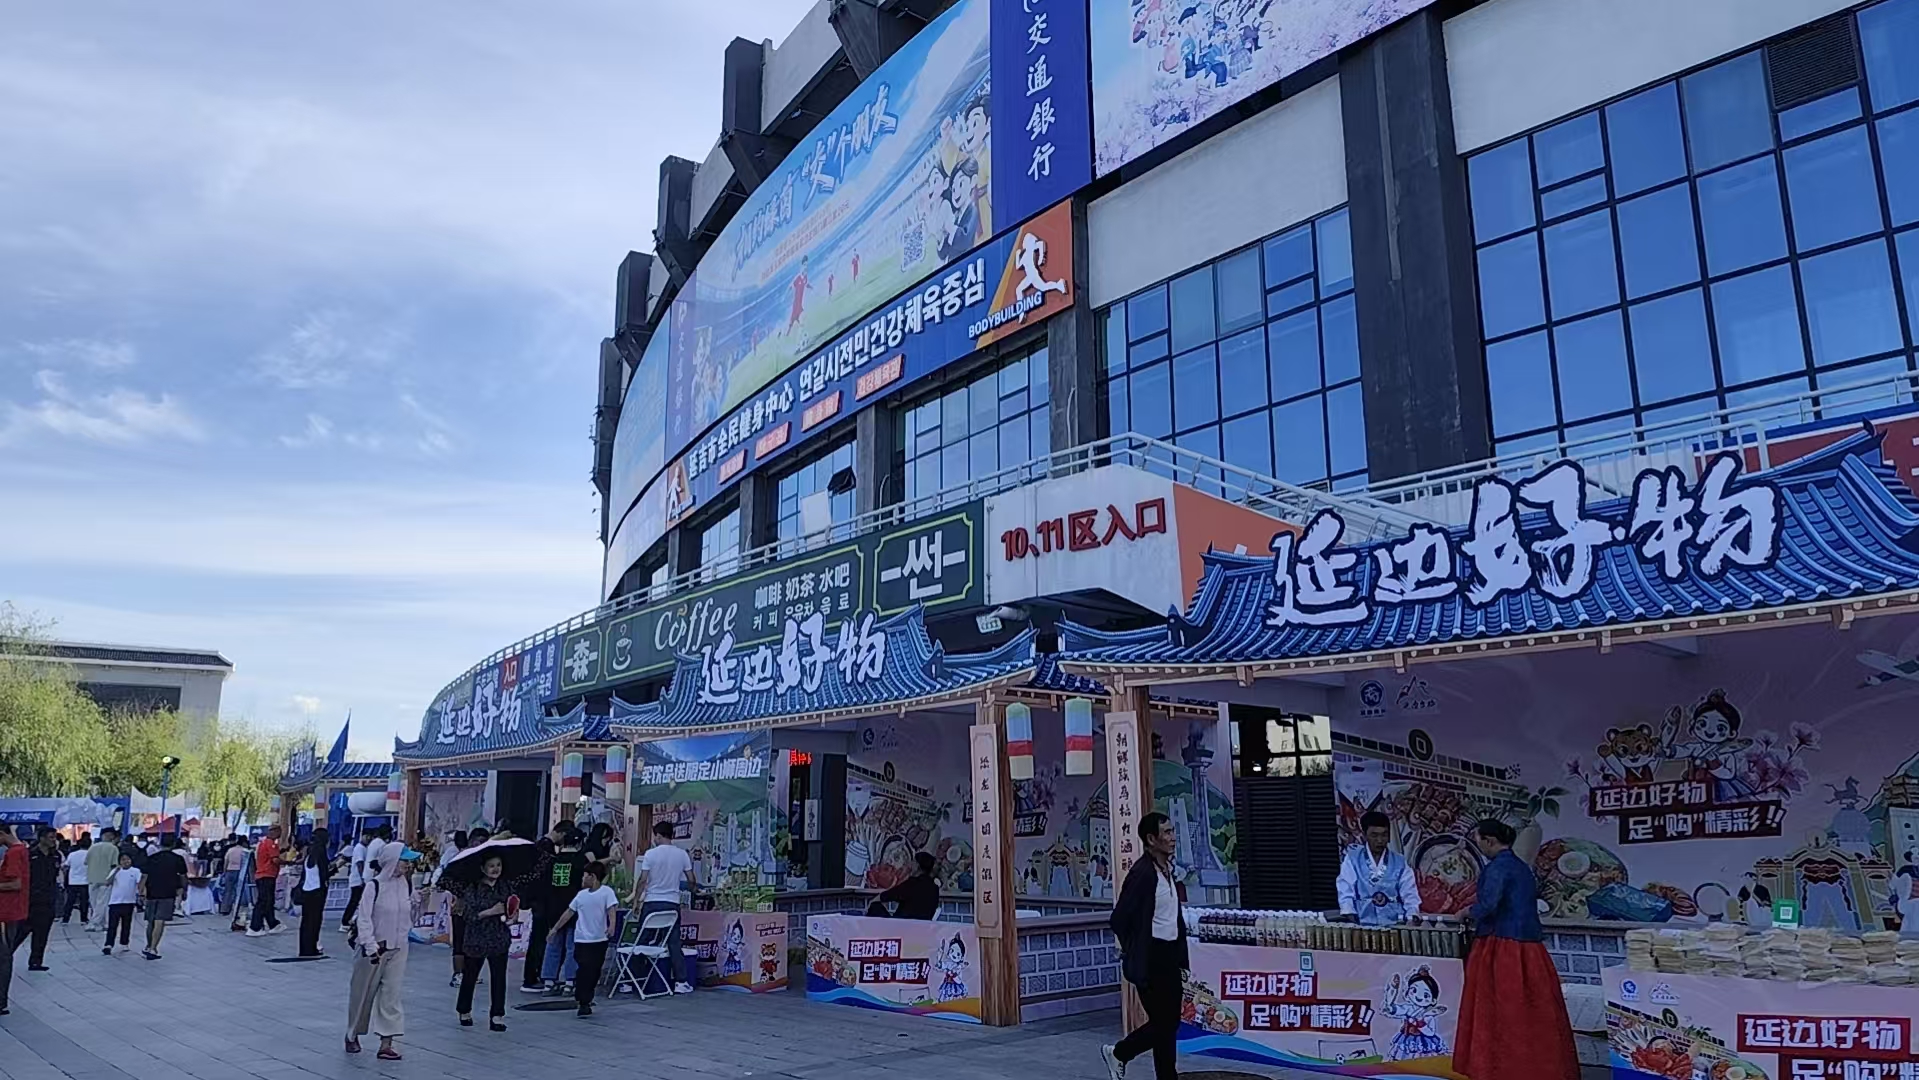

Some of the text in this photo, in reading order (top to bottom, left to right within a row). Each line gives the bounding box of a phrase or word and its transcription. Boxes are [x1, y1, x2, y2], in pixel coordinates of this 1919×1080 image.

[968, 291, 1042, 339] BODYBUILDING
[1267, 456, 1779, 627] 延边好物
[755, 562, 850, 610] 咖啡 奶茶 水吧
[655, 598, 738, 653] Coffee
[697, 612, 886, 704] 延边好物
[1595, 782, 1707, 811] 延边好物
[1225, 974, 1313, 997] 延边好物
[1745, 1018, 1902, 1050] 延边好物
